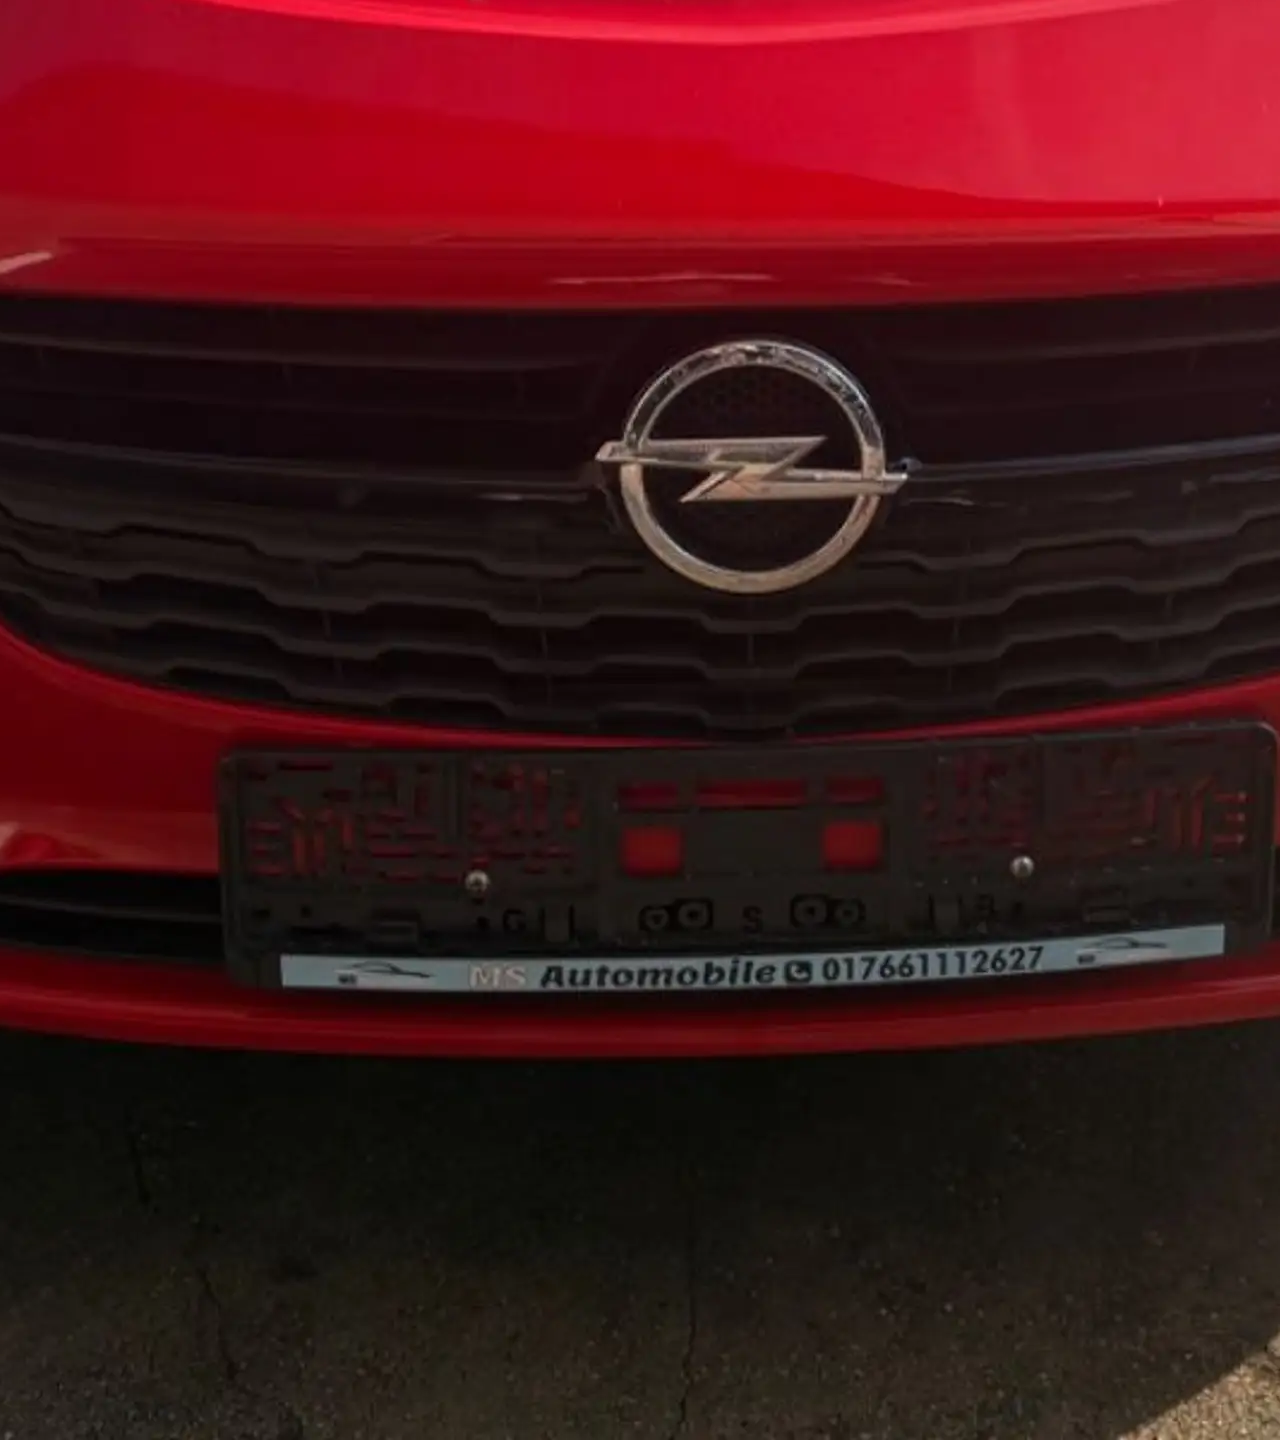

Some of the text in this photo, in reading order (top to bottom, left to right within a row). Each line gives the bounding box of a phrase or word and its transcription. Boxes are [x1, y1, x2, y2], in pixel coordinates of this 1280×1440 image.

[471, 946, 1045, 988] MS Automobile 017661112627
